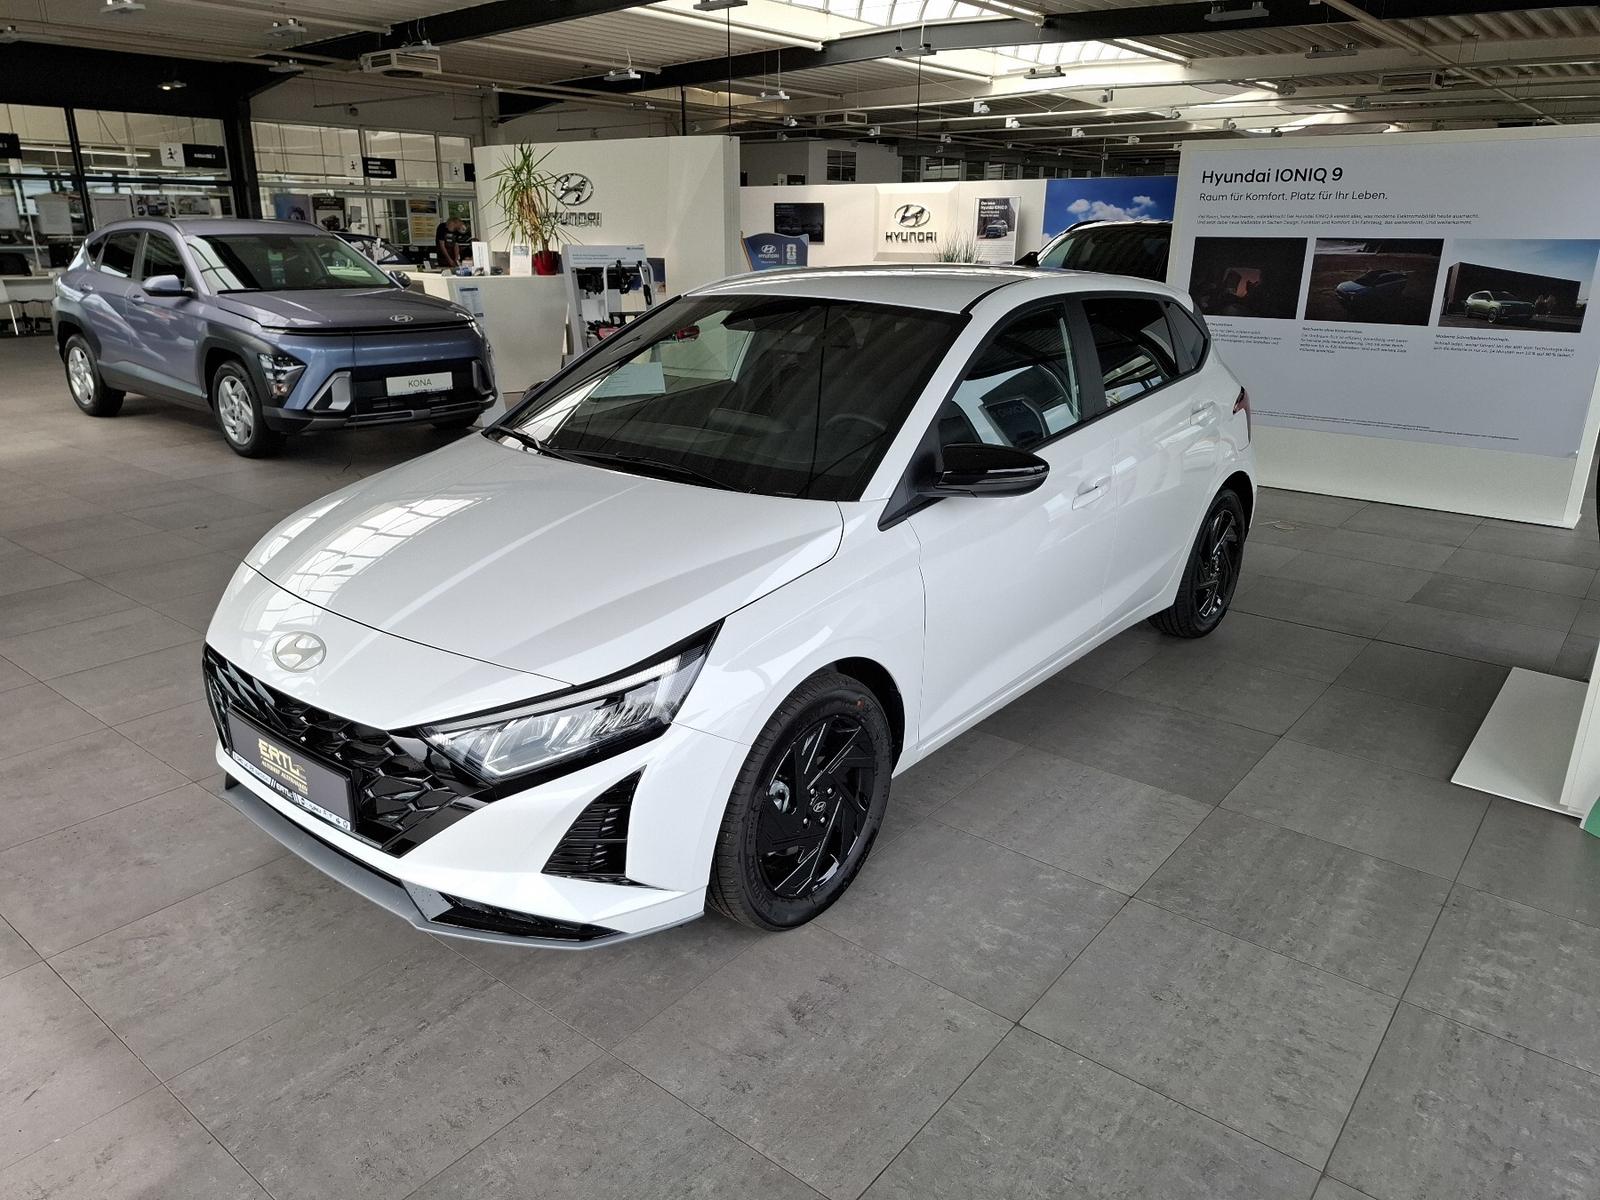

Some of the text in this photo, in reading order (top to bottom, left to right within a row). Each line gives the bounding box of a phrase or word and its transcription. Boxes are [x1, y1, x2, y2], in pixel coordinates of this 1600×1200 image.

[1201, 167, 1343, 186] Hyundai IONIQ 9
[1199, 190, 1388, 201] Raum für Komfort. Platz für Ihr Leben.
[885, 231, 938, 243] HYUNDAI
[407, 377, 433, 389] KONA
[258, 737, 300, 778] ERTL
